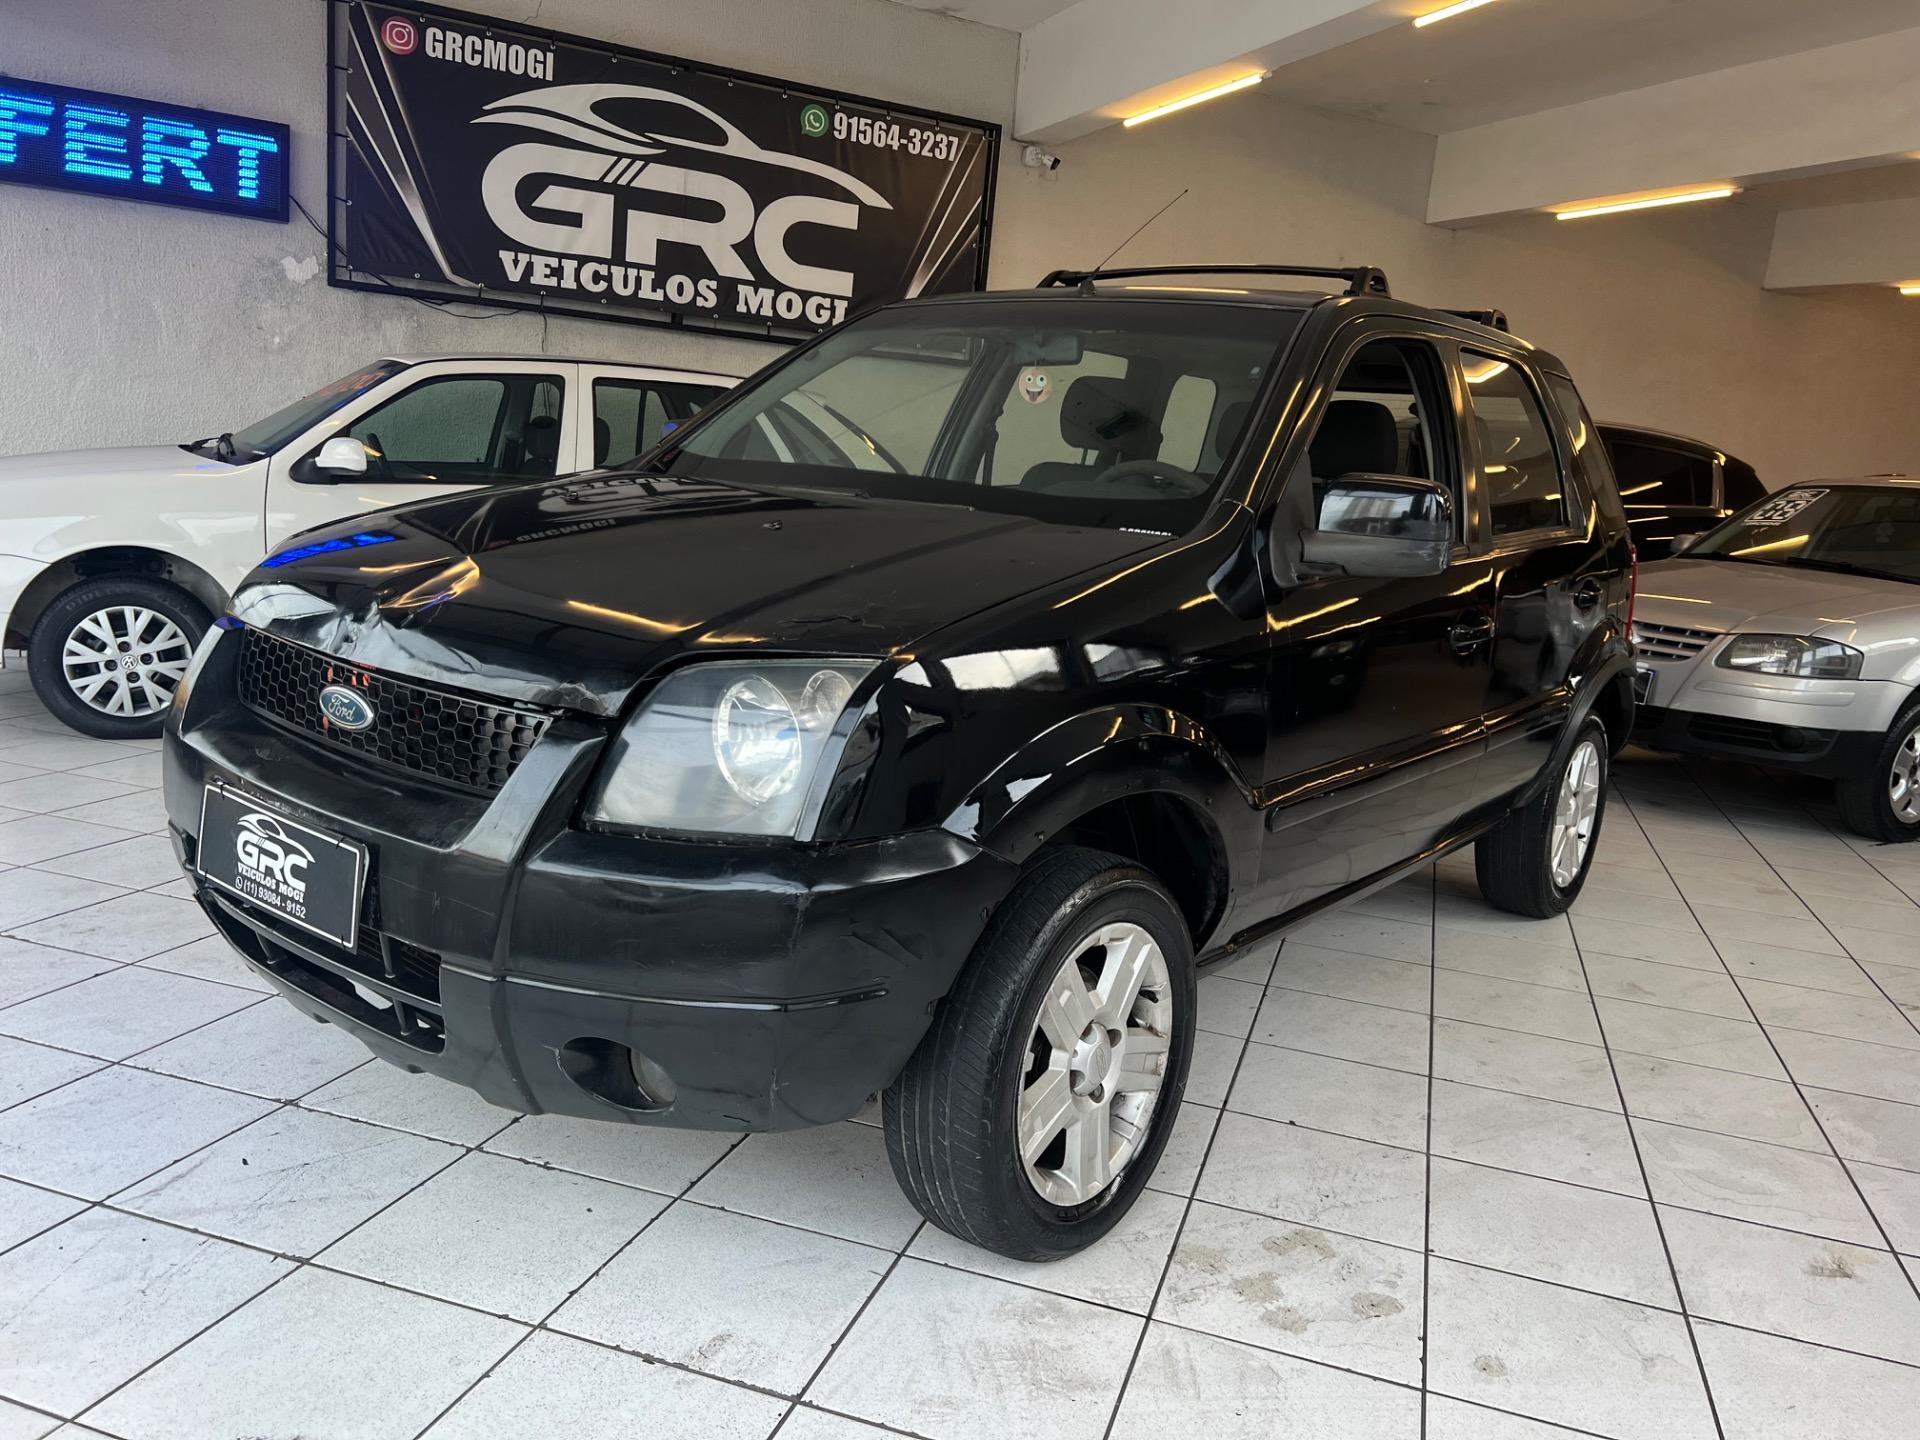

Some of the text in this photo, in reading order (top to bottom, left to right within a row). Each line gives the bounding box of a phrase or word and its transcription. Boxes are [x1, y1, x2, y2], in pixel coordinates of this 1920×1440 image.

[425, 26, 555, 82] GRCMOGI
[0, 92, 279, 199] FERT
[833, 112, 959, 162] 91564-3237
[481, 142, 860, 298] GRC
[499, 250, 849, 326] VEICULOS MOGI
[328, 693, 356, 721] Ford
[236, 829, 308, 892] GRC
[237, 861, 305, 903] VEICULOS MOGI
[243, 879, 257, 898] (11)
[286, 899, 307, 919] 9152
